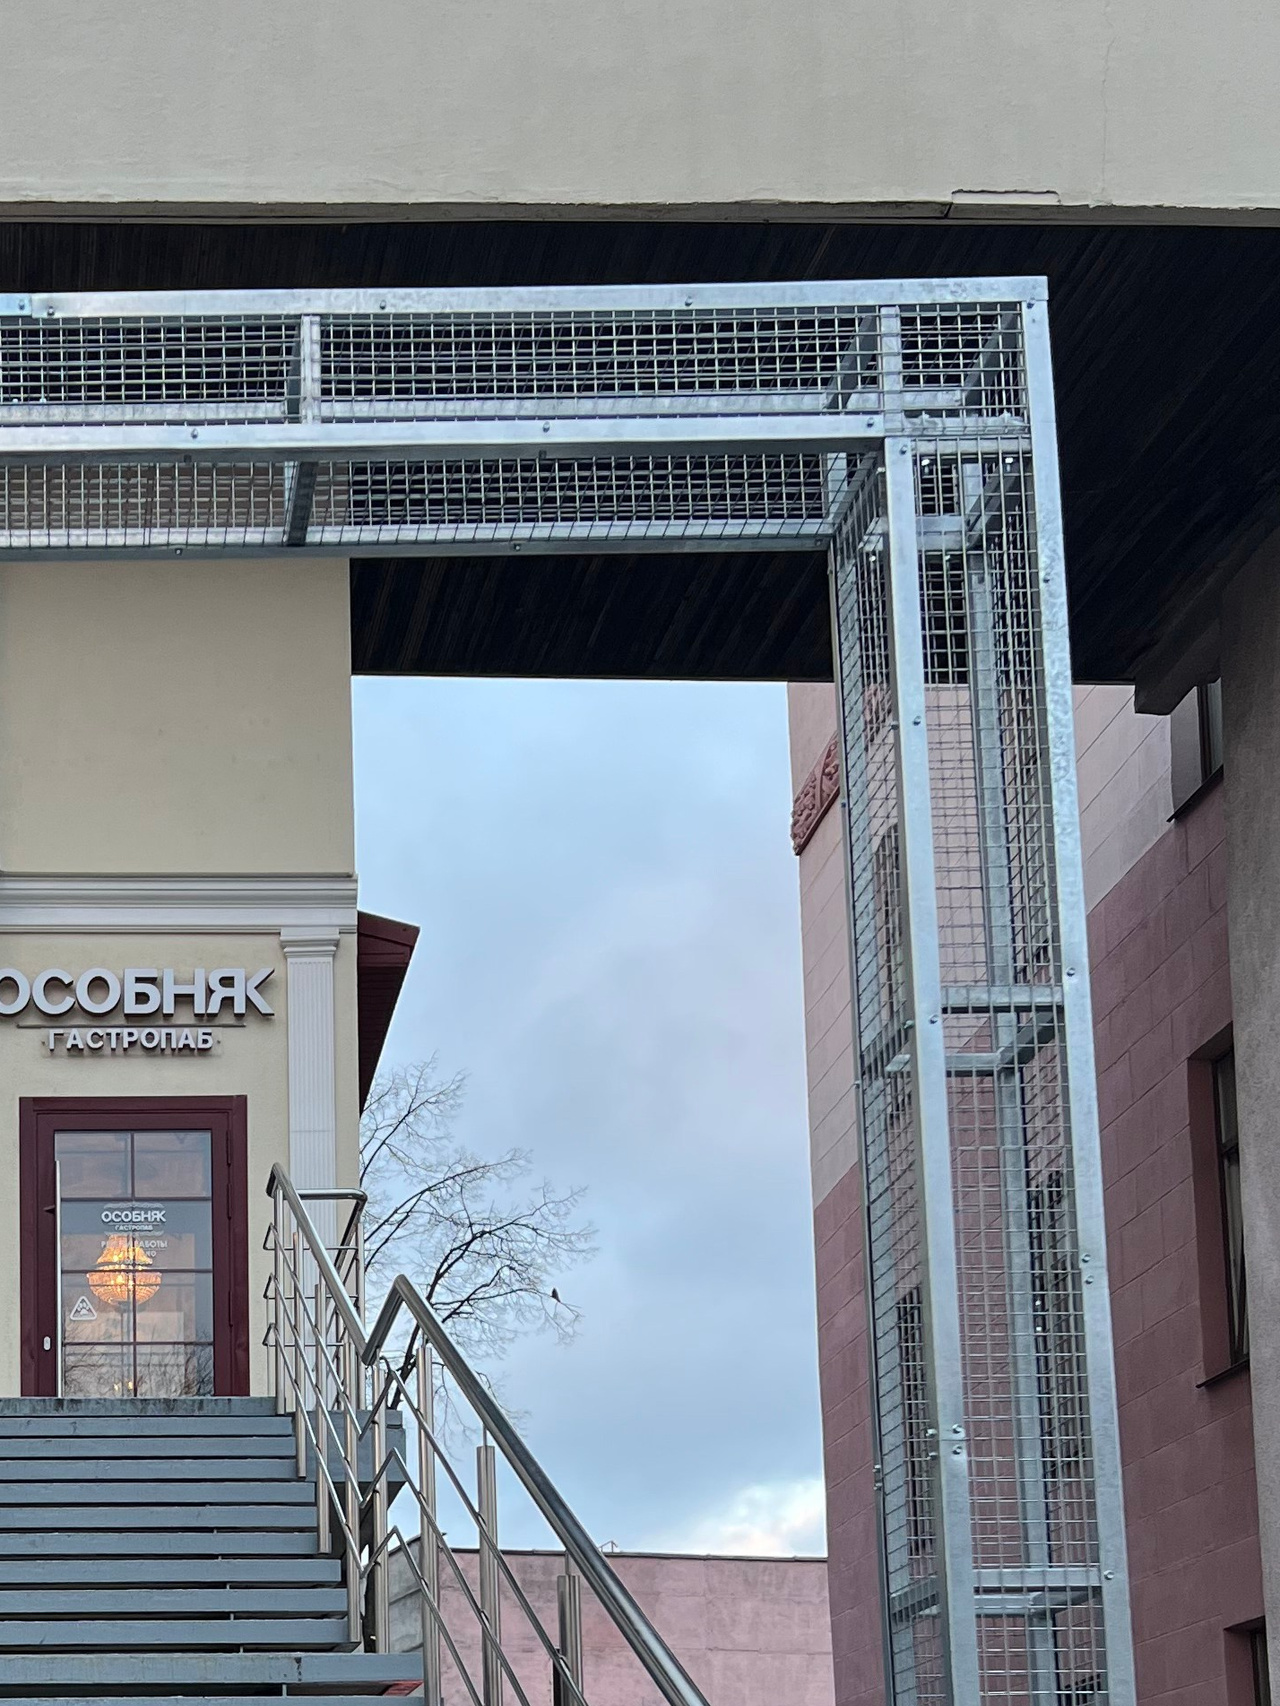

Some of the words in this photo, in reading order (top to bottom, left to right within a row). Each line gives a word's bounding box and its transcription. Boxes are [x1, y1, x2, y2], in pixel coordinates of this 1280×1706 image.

[48, 1028, 215, 1051] ГАСТРОПАБ
[101, 1210, 167, 1223] ОСОБНЯК
[114, 1224, 154, 1232] ГАСТРОПАБ
